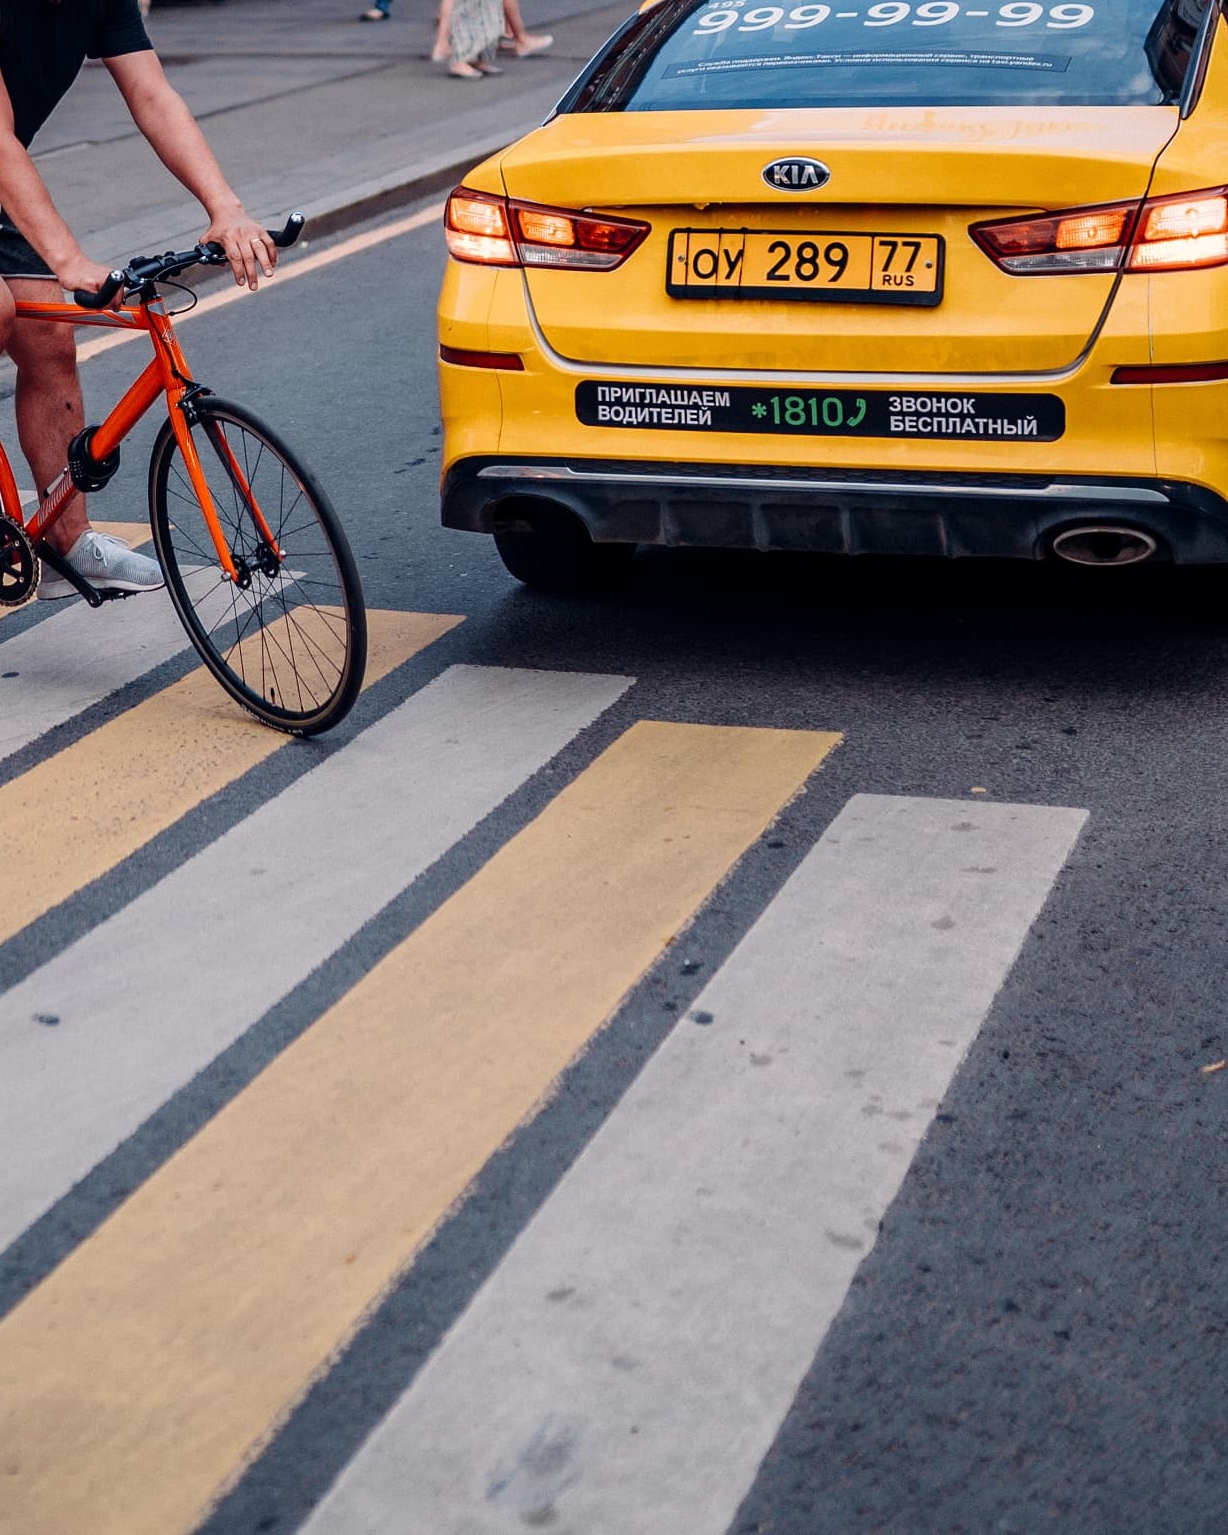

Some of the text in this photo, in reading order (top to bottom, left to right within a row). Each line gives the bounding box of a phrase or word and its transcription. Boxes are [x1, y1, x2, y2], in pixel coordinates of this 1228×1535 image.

[708, 0, 747, 11] 495
[693, 1, 1095, 36] 999-99-99
[773, 165, 820, 185] KIA
[766, 240, 849, 283] 289
[878, 240, 922, 273] 77
[882, 274, 915, 287] RUS
[597, 386, 731, 407] ПРИГЛАШАЕМ
[888, 396, 976, 414] ЗВОНОК
[597, 405, 712, 426] ВОДИТЕЛЕЙ
[889, 415, 1038, 435] БЕСПЛАТНЫЙ
